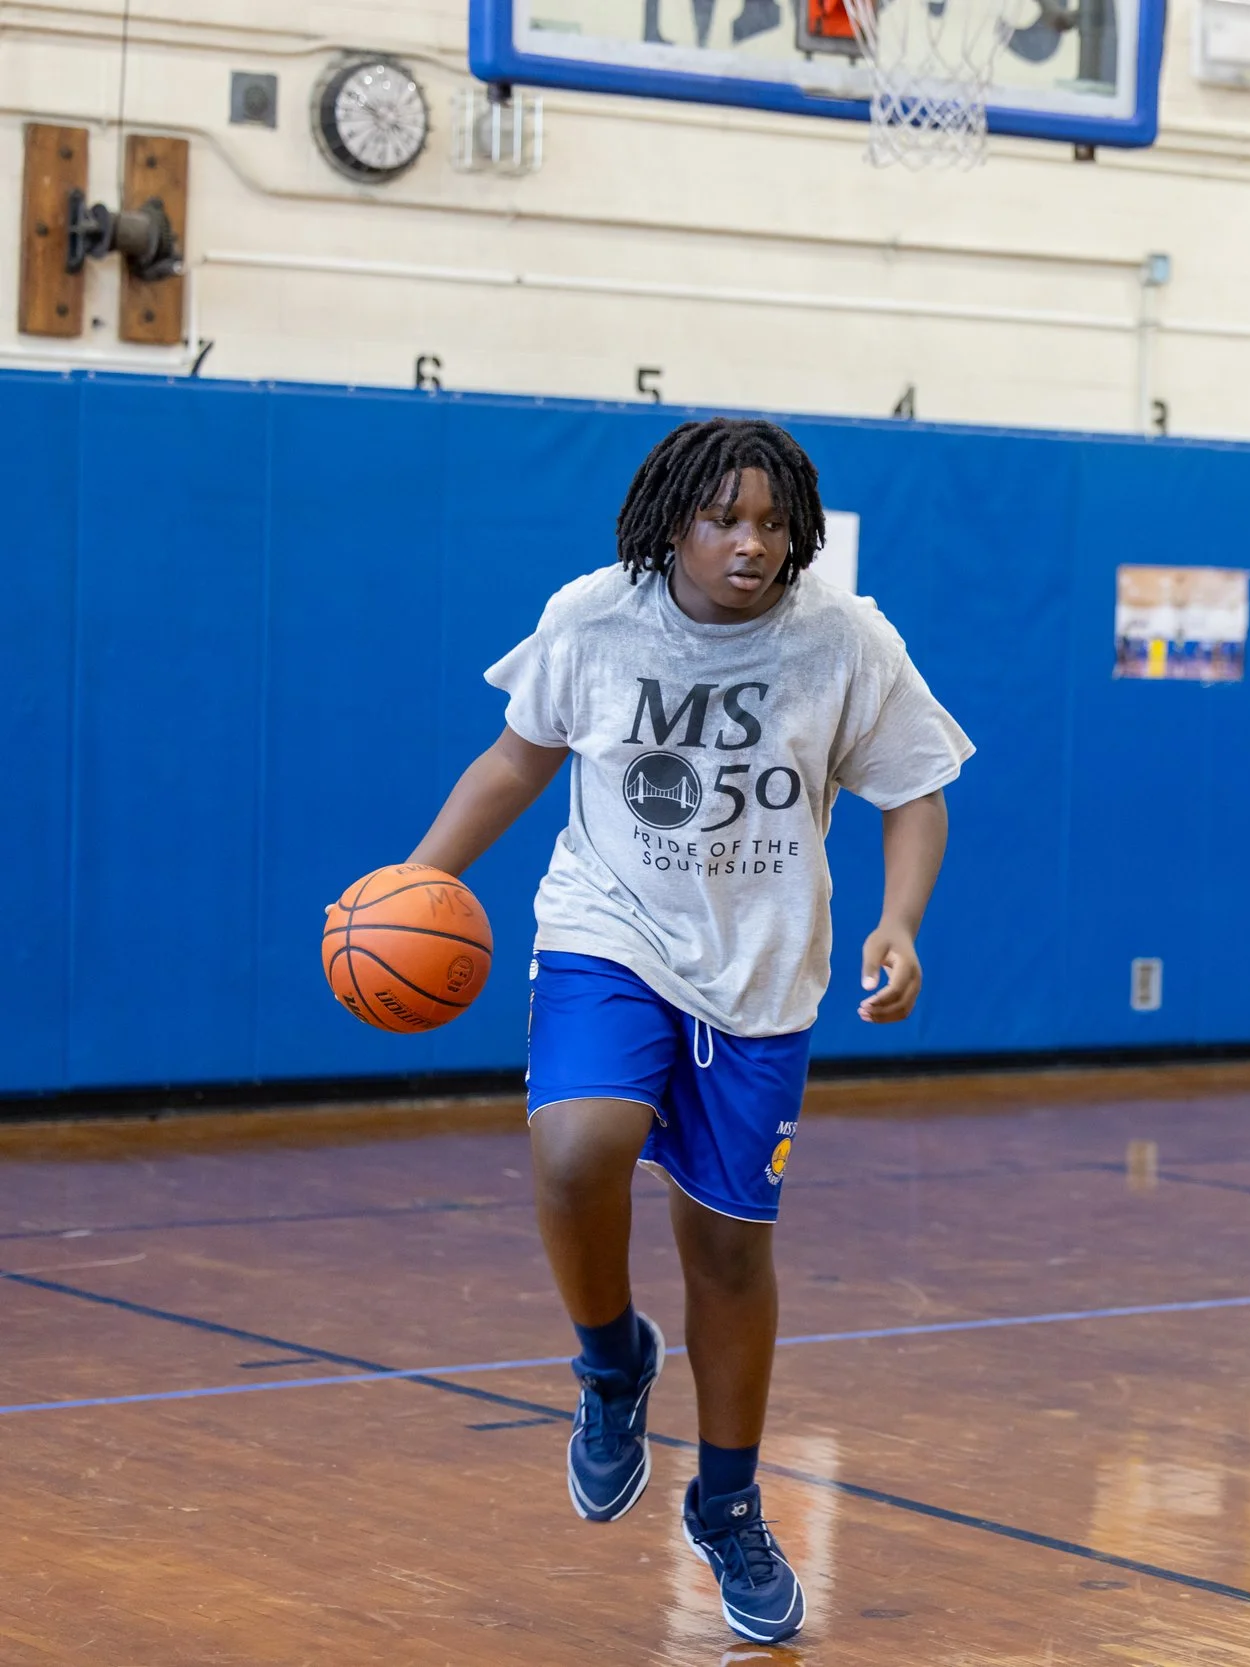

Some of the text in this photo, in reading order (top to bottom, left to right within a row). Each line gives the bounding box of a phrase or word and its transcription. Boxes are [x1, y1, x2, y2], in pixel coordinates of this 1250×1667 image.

[622, 677, 769, 751] MS
[700, 763, 801, 833] 50
[642, 851, 784, 877] SOUTHSIDE
[710, 840, 741, 858] OF
[752, 839, 799, 856] THE
